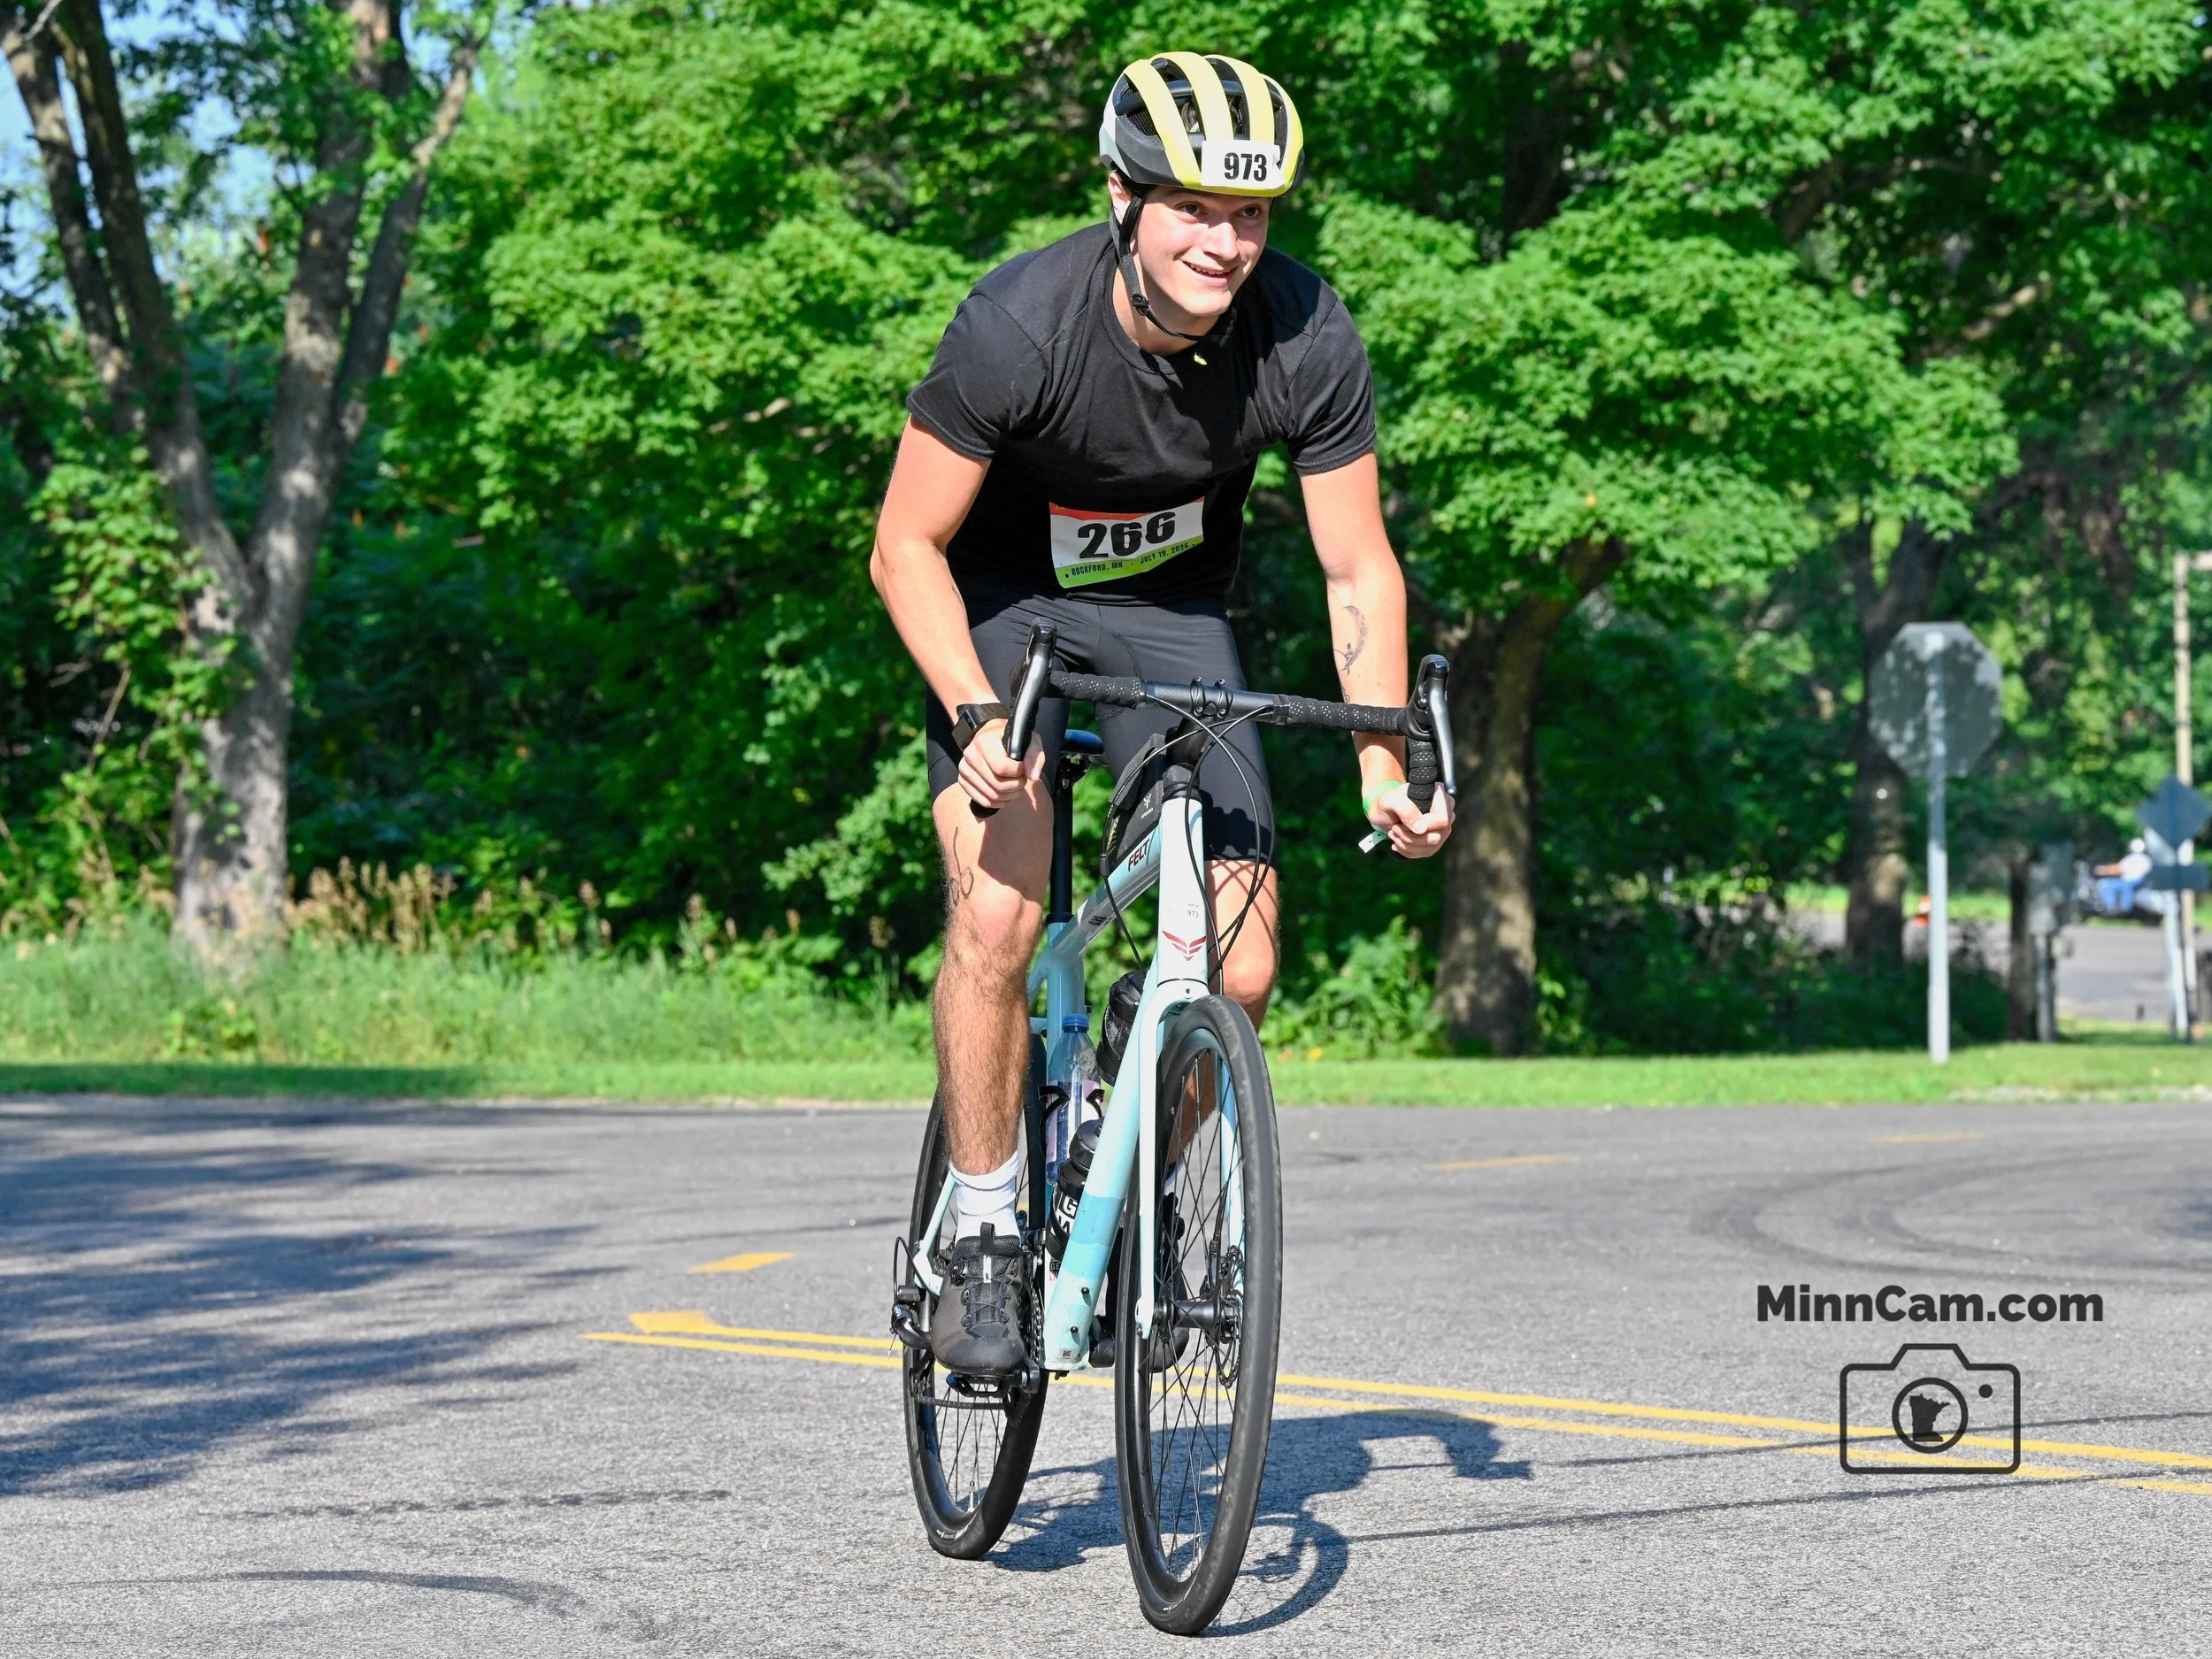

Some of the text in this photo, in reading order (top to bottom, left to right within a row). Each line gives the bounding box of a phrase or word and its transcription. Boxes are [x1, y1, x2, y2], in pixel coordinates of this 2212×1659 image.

[1224, 152, 1267, 182] 973
[1077, 511, 1176, 559] 266
[1140, 553, 1156, 565] JULY
[1128, 838, 1150, 872] FELT
